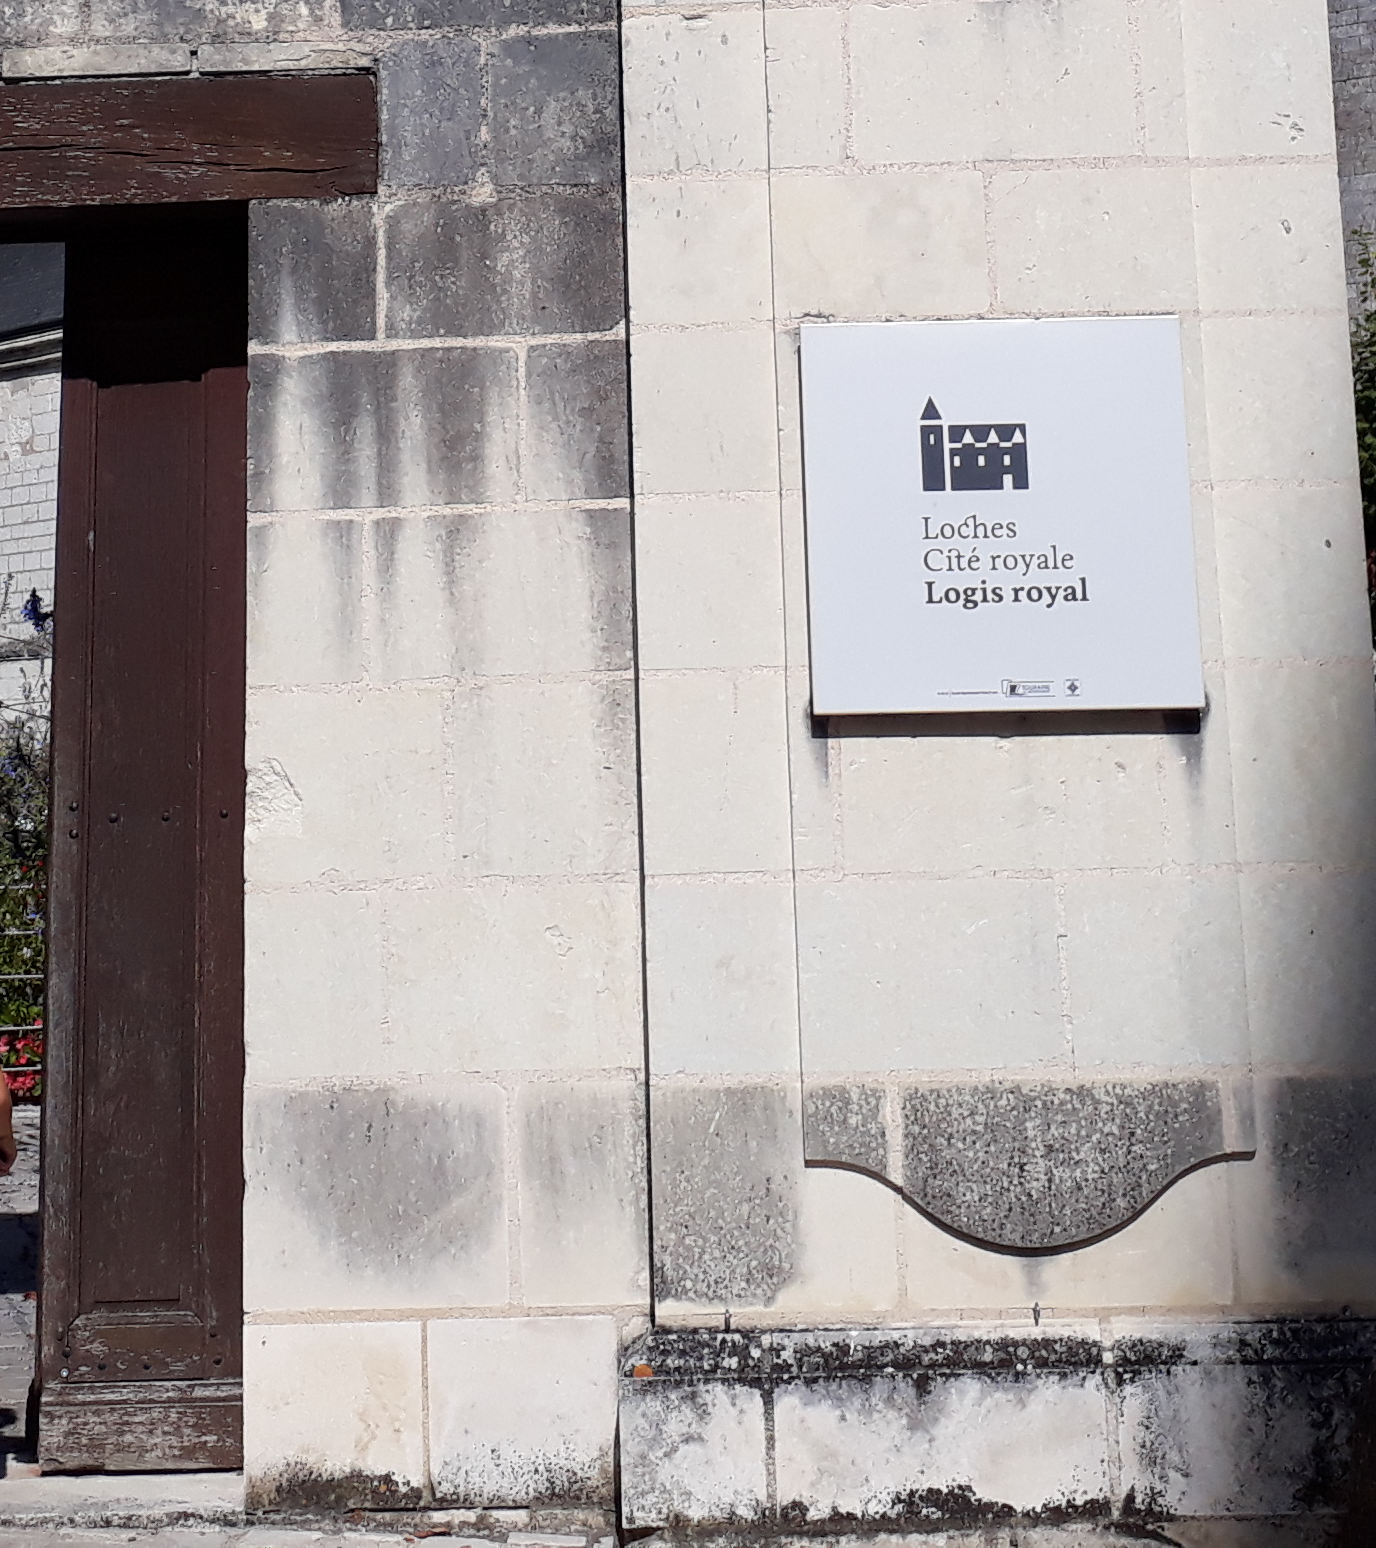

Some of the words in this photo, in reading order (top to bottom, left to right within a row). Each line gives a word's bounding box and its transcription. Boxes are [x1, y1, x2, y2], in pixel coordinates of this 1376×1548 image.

[921, 514, 1017, 540] Loches
[923, 546, 981, 572] Cité
[989, 544, 1074, 577] royale
[924, 579, 1004, 610] Logis
[1011, 576, 1090, 609] royal
